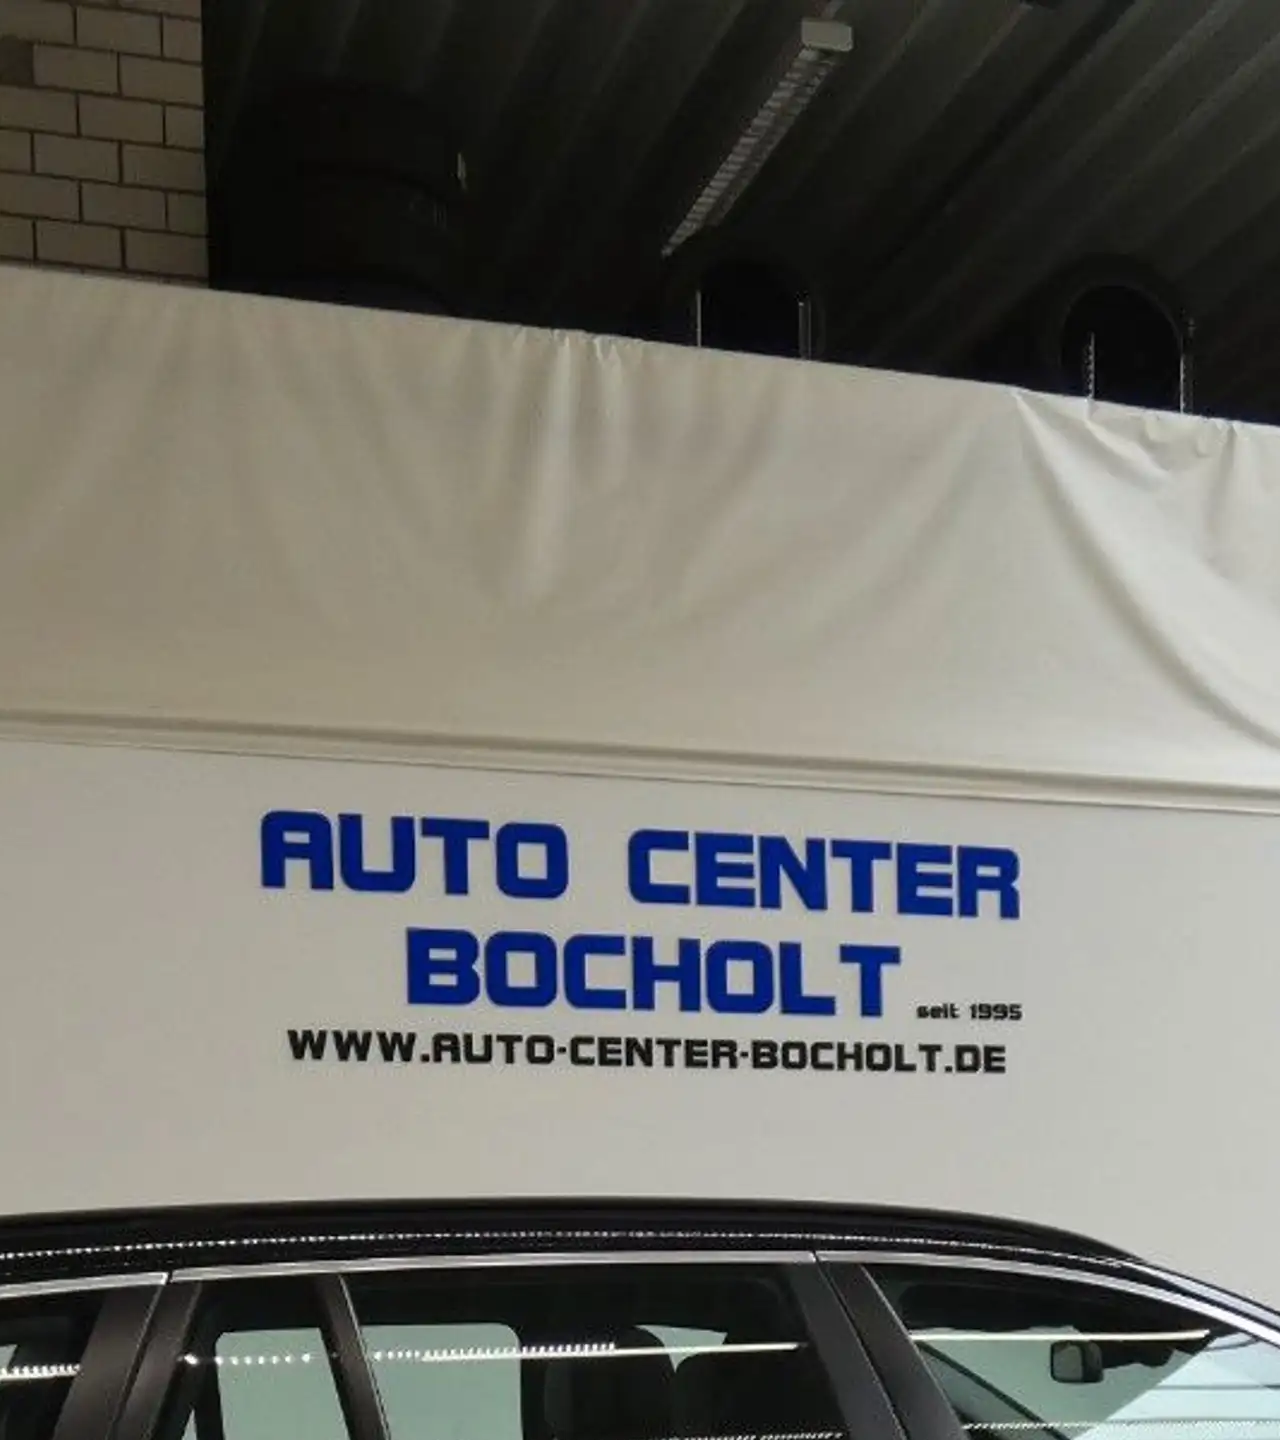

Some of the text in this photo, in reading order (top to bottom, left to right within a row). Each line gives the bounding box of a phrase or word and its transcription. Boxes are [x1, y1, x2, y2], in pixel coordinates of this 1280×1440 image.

[260, 810, 1021, 921] AUTO CENTER
[406, 927, 1023, 1021] BOCHOLT seit 1995
[287, 1029, 1006, 1074] WWW.AUTO-CENTER-BOCHOLT.DE
